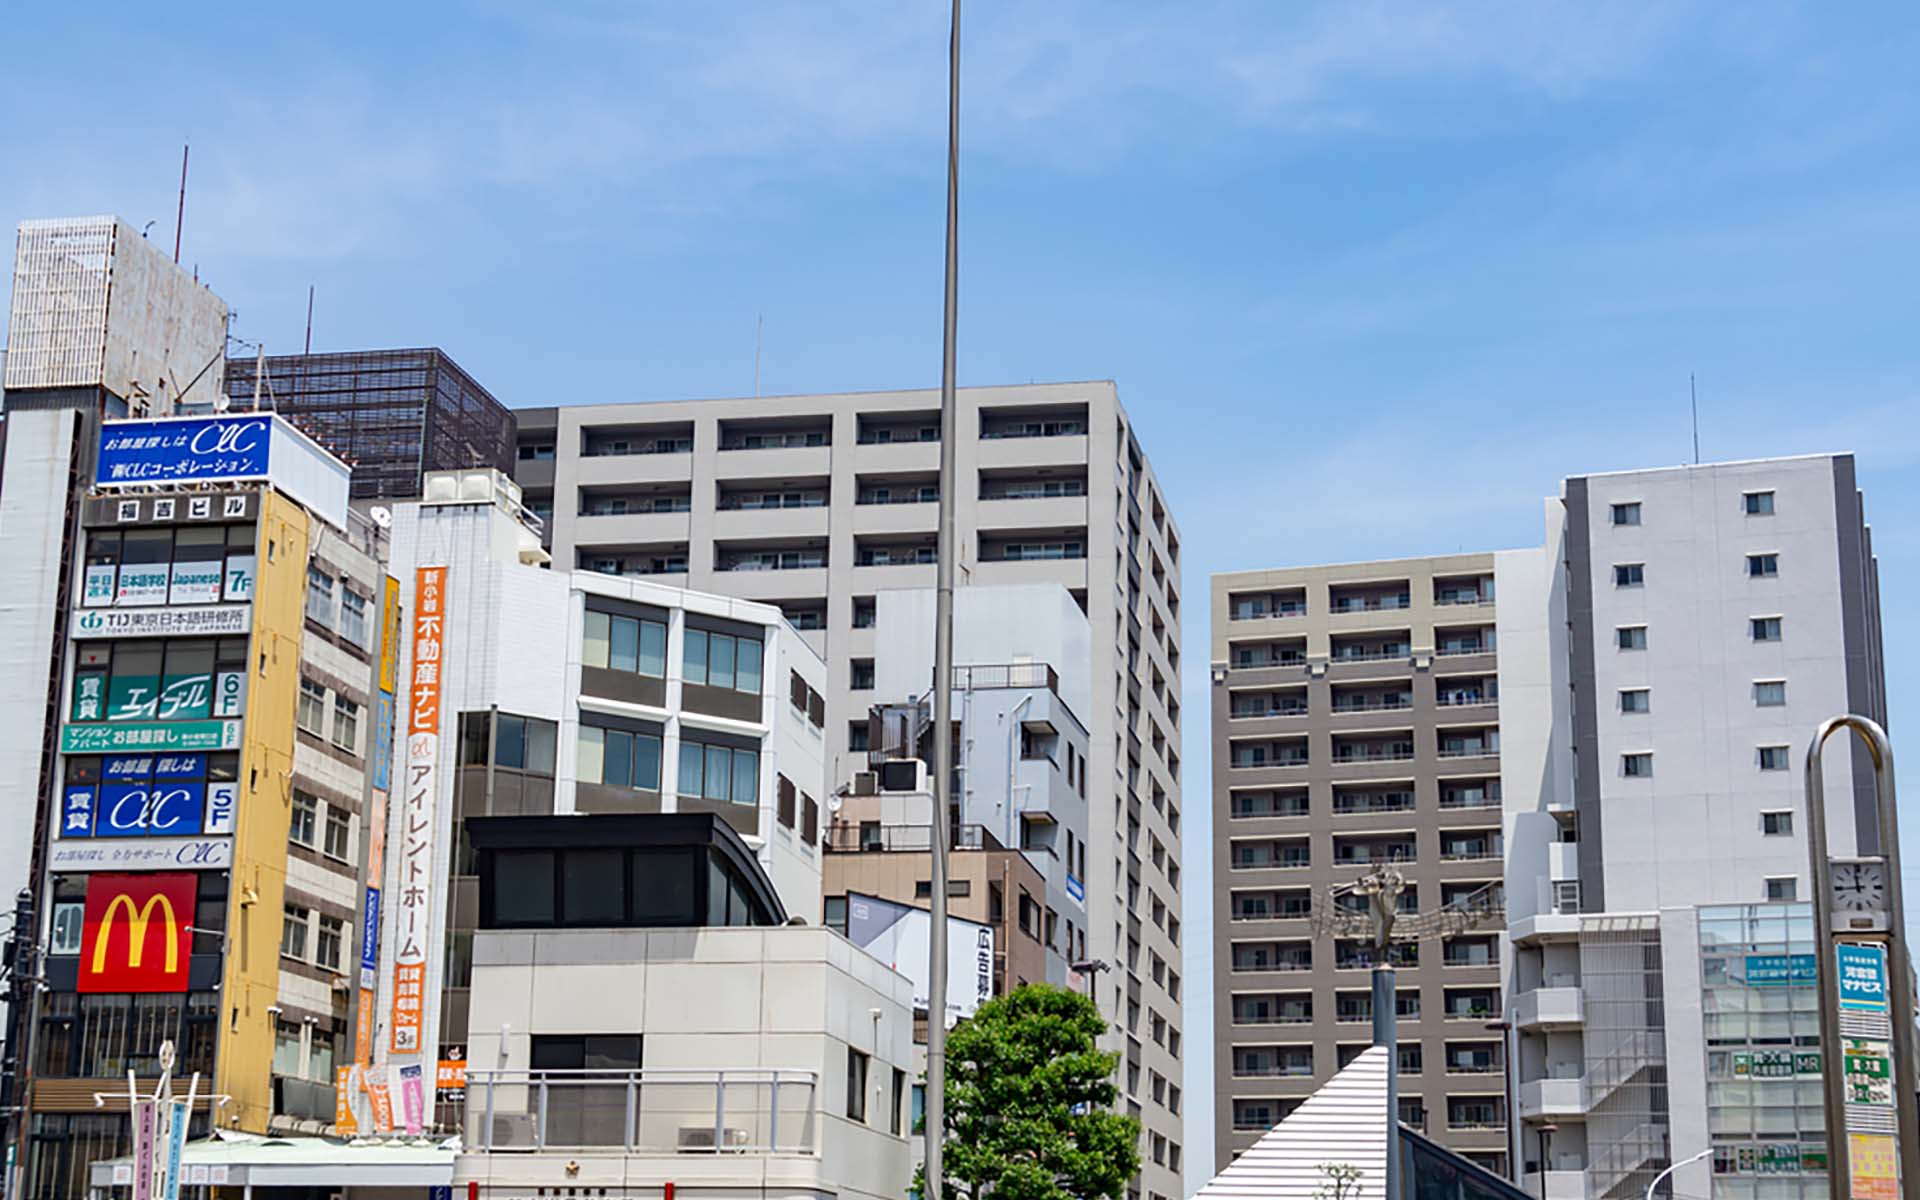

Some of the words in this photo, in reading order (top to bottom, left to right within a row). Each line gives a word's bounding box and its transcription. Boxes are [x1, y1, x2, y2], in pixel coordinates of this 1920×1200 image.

[120, 573, 166, 587] 日本語学校
[172, 572, 221, 586] Japanese
[229, 570, 252, 593] 7F
[105, 626, 134, 634] TOKYO
[136, 625, 182, 634] INSTITUTE
[184, 624, 197, 632] OF
[198, 623, 242, 632] JAPANESE
[414, 615, 441, 729] 不動産ナビ
[78, 677, 100, 719] 賃貸
[108, 675, 210, 720] エイブル
[223, 674, 239, 715] 6F
[69, 727, 112, 738] マンション
[69, 738, 111, 749] アパート
[113, 728, 178, 745] お部屋探し
[66, 792, 92, 830] 賃貸
[211, 788, 233, 827] 5F
[400, 766, 431, 957] アイレントホーム
[977, 928, 990, 1006] 広告募
[1842, 979, 1882, 994] マナビス
